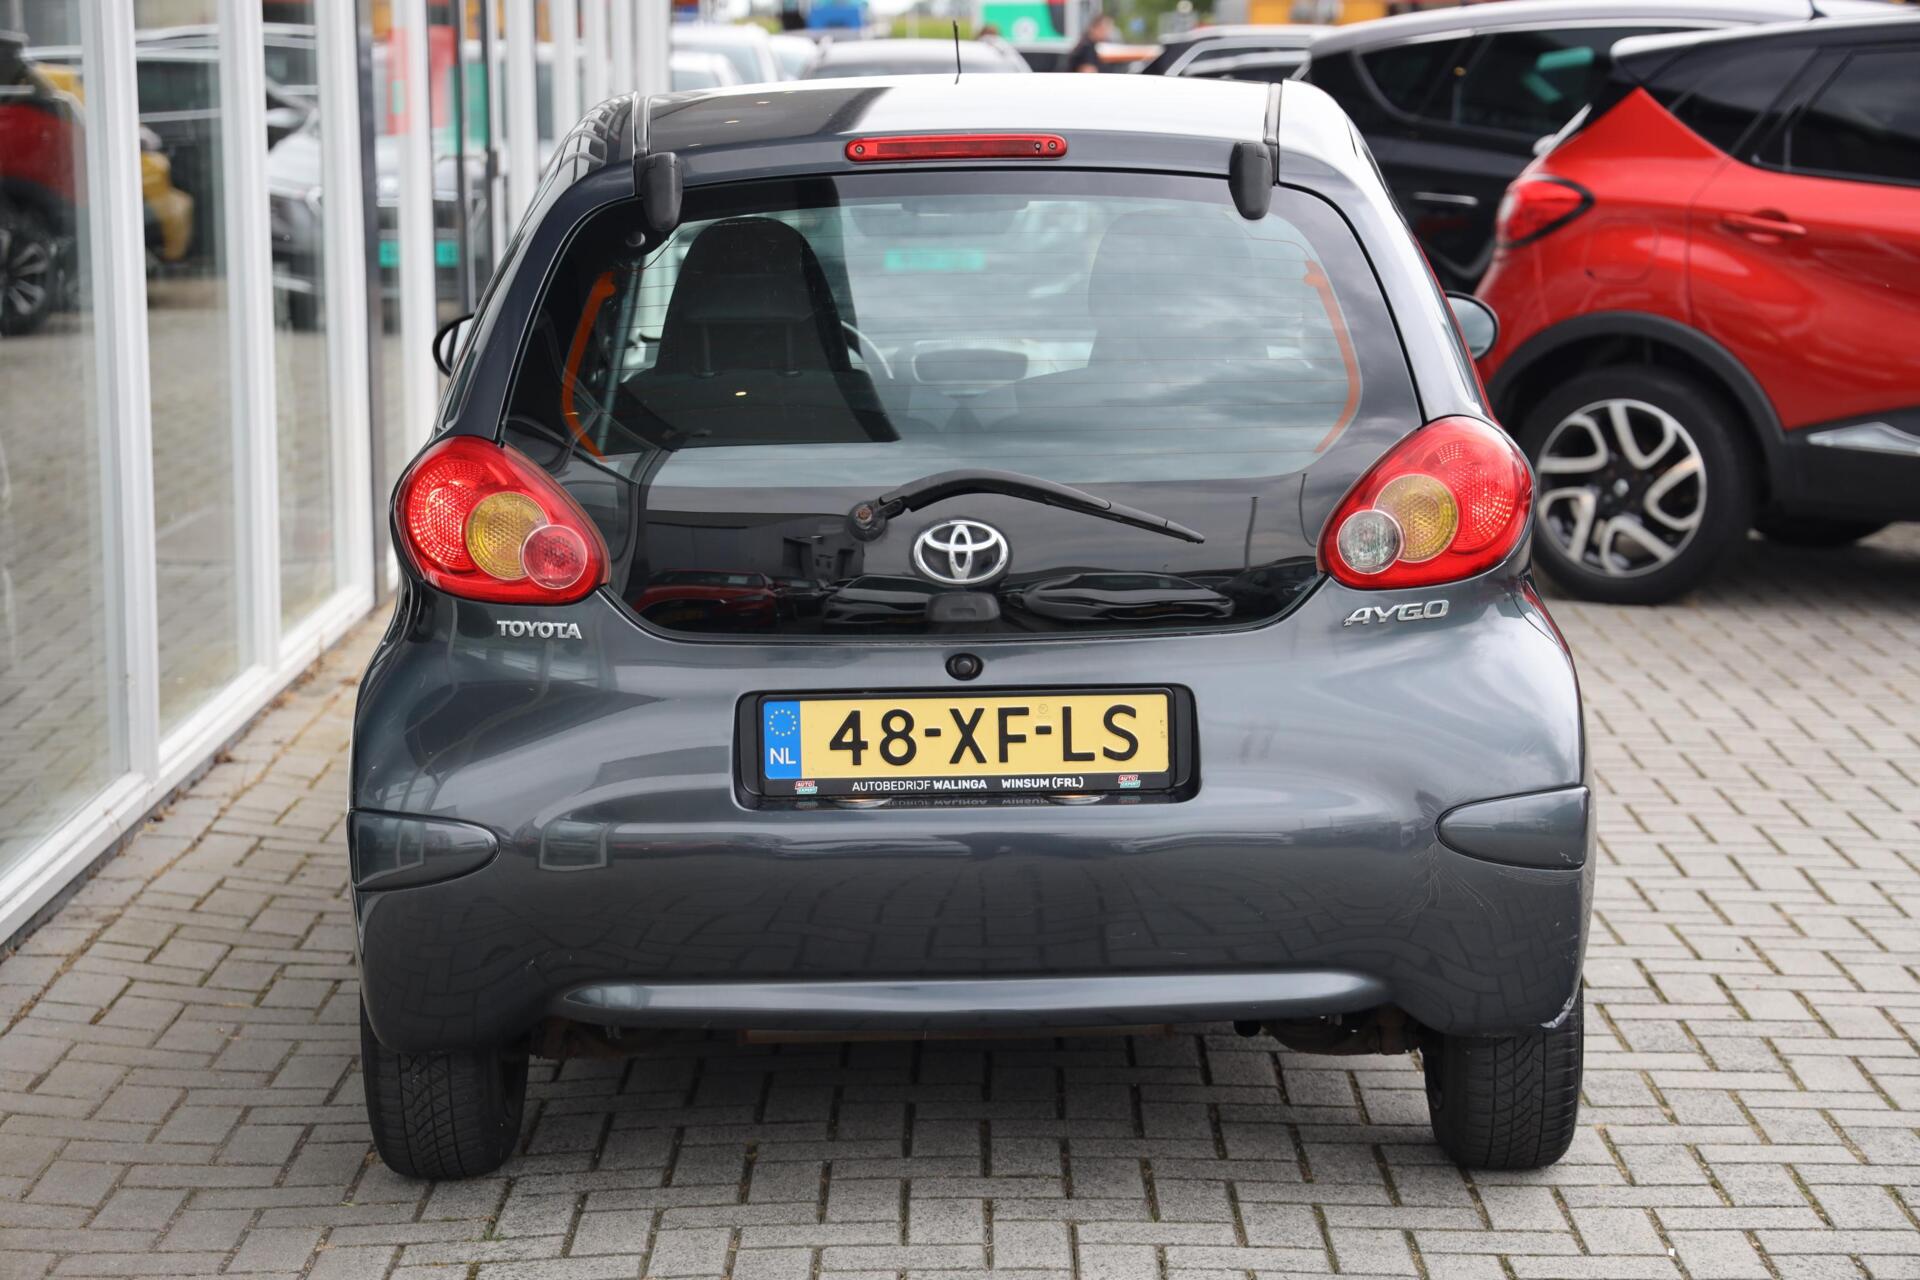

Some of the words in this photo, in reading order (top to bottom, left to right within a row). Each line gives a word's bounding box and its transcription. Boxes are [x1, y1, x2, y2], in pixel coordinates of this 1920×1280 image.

[1343, 599, 1450, 627] AYGO
[496, 619, 582, 640] TOYOTA
[829, 703, 1139, 766] 48-XF-LS
[769, 747, 797, 765] NL
[851, 780, 931, 792] AUTOBEDRIJF
[933, 779, 988, 791] WALINGA
[1001, 778, 1050, 790] WINSUM
[1051, 776, 1085, 789] (FRL)
